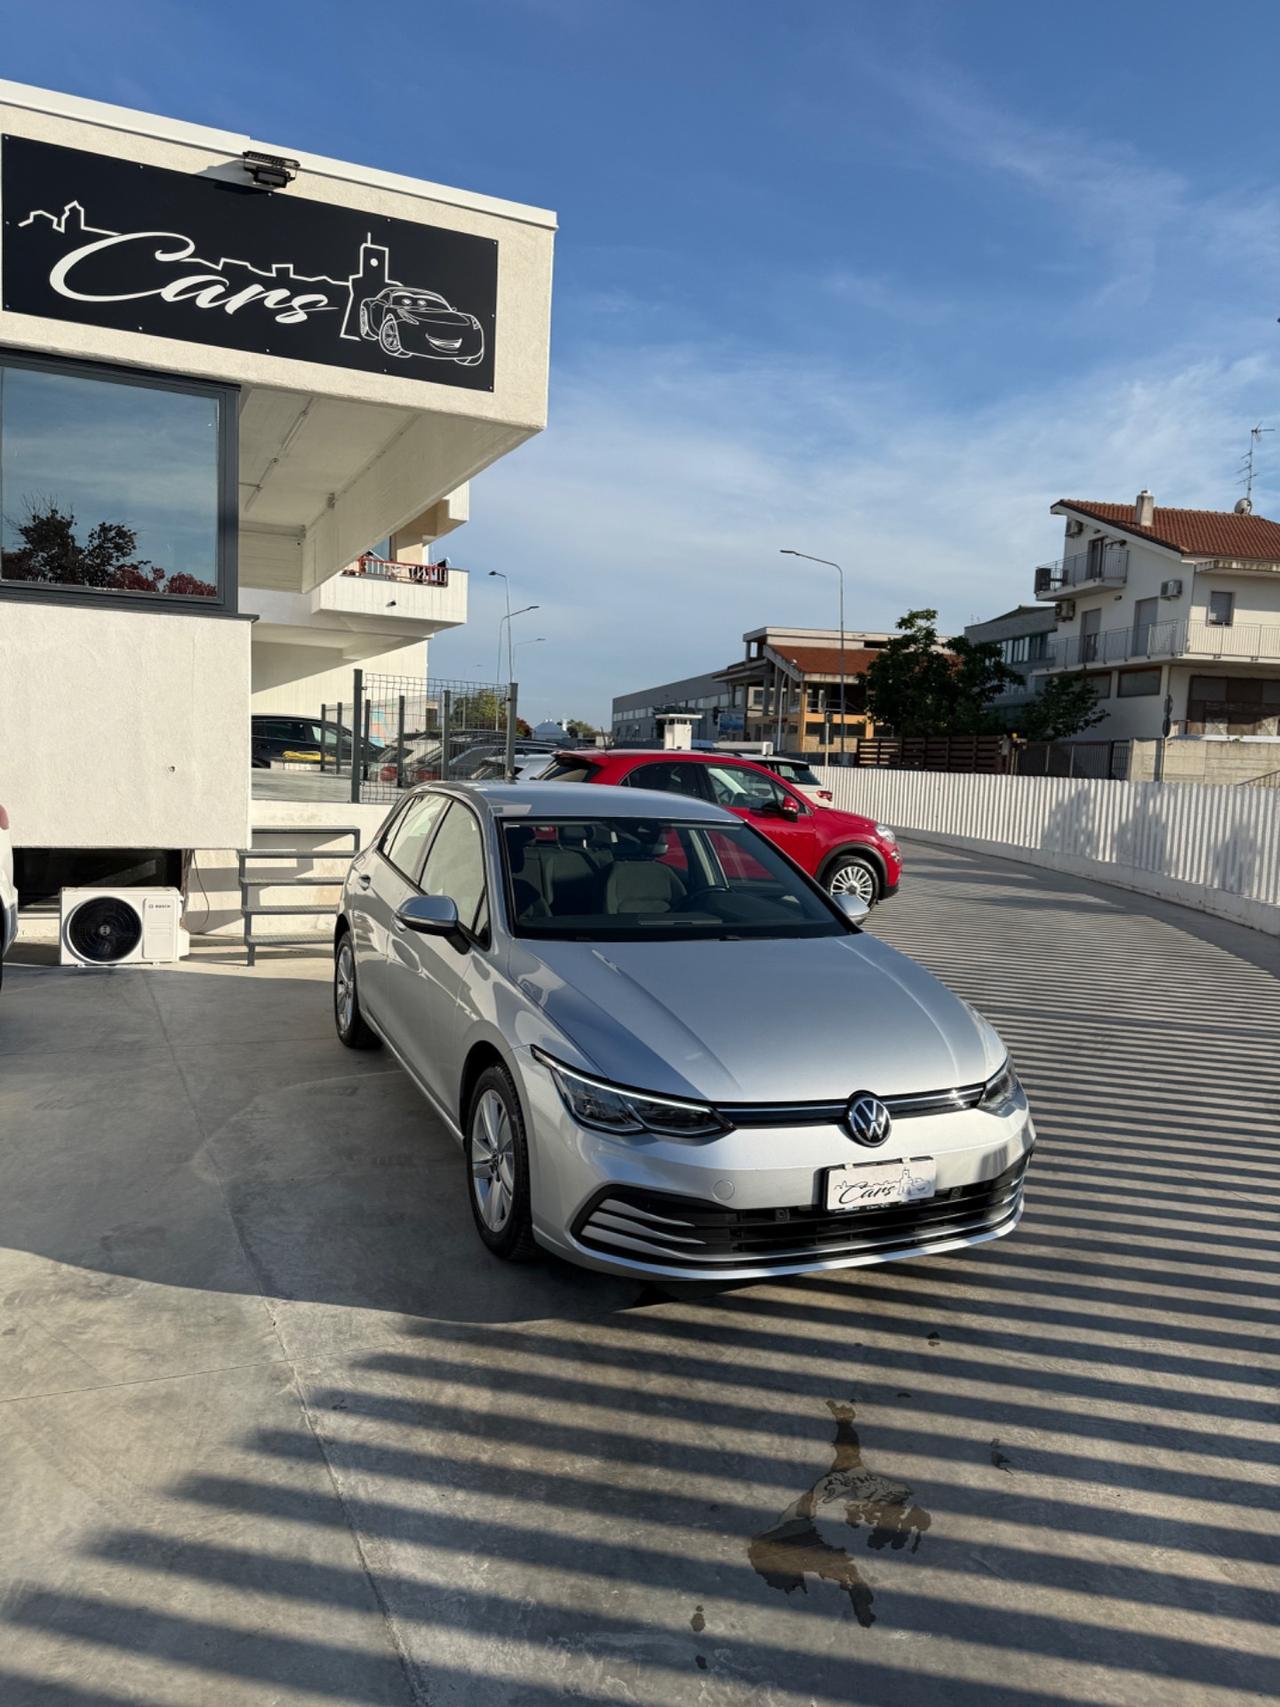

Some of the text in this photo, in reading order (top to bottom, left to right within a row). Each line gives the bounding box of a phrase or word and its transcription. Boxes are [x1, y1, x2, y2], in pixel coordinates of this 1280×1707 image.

[49, 231, 338, 324] Cars
[851, 1098, 890, 1143] VW
[839, 1181, 896, 1205] Cars
